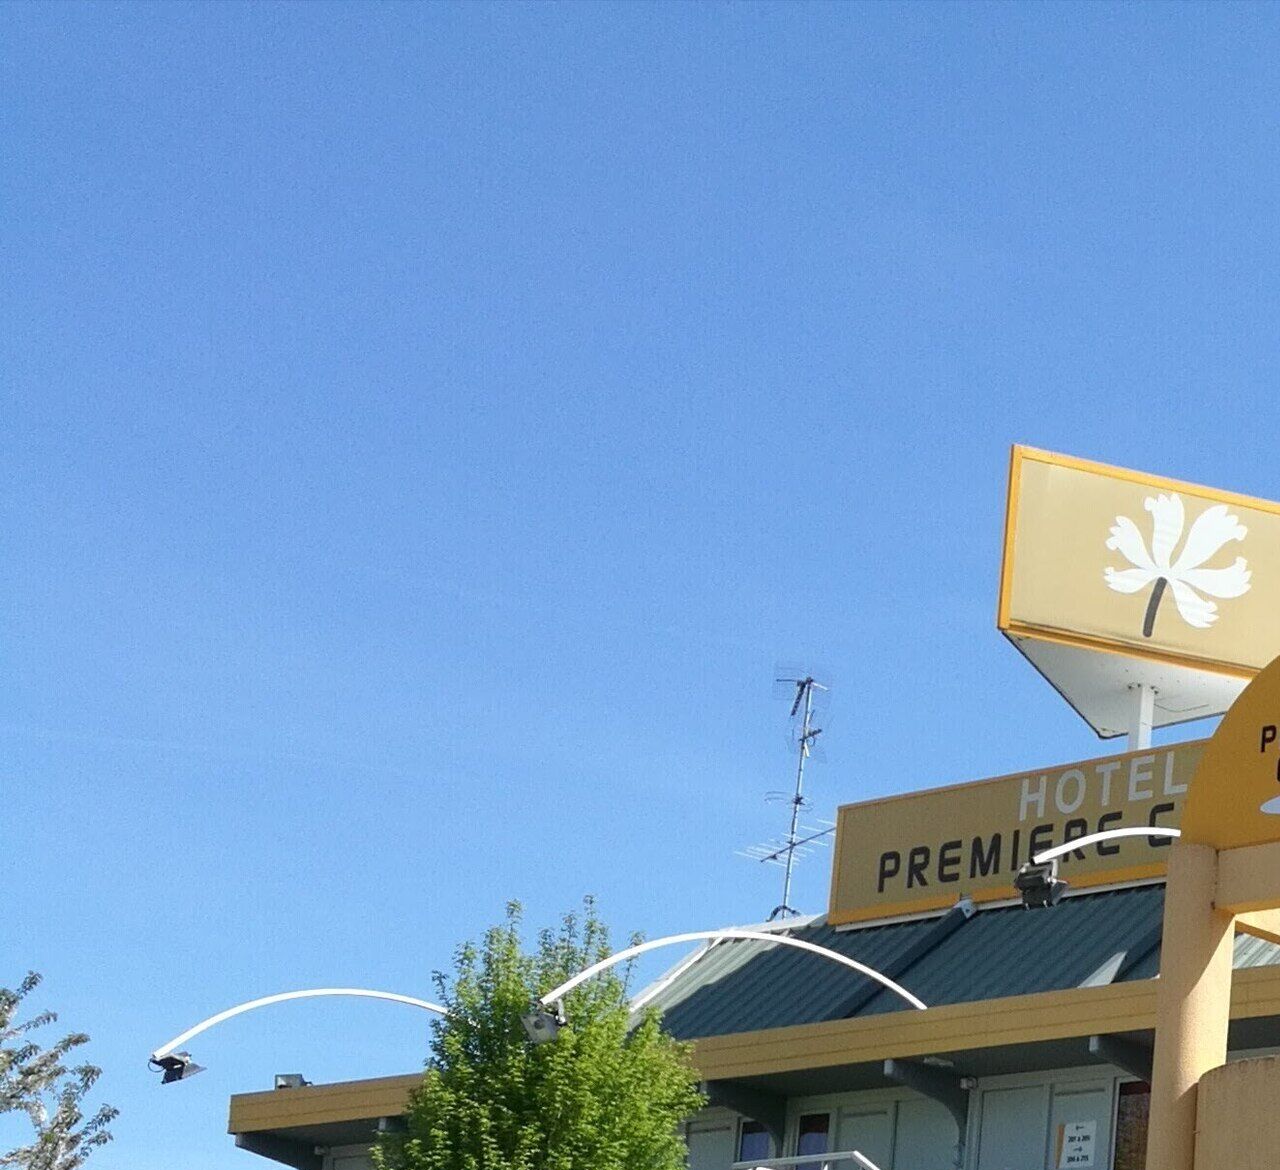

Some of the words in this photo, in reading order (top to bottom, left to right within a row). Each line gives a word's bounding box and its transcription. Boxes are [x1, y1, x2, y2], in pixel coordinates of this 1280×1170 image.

[1019, 751, 1188, 822] HOTEL
[877, 811, 1124, 894] PREMIERE
[1148, 802, 1175, 848] C
